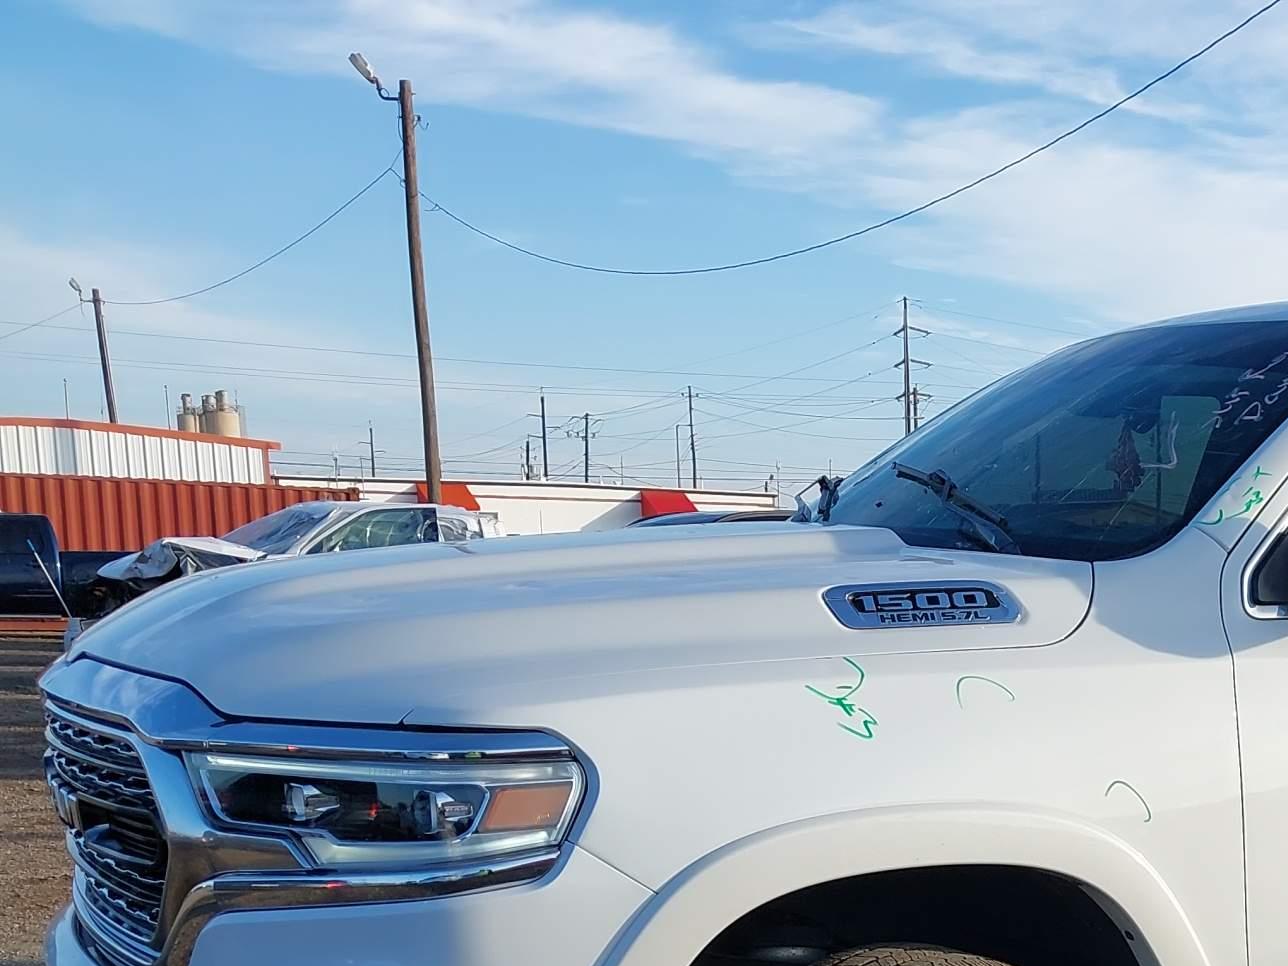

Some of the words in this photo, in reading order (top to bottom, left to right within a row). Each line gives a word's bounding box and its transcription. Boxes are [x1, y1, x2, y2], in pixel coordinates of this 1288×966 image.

[855, 590, 989, 613] 1500
[880, 612, 934, 625] HEMI
[941, 609, 990, 622] 5.7L
